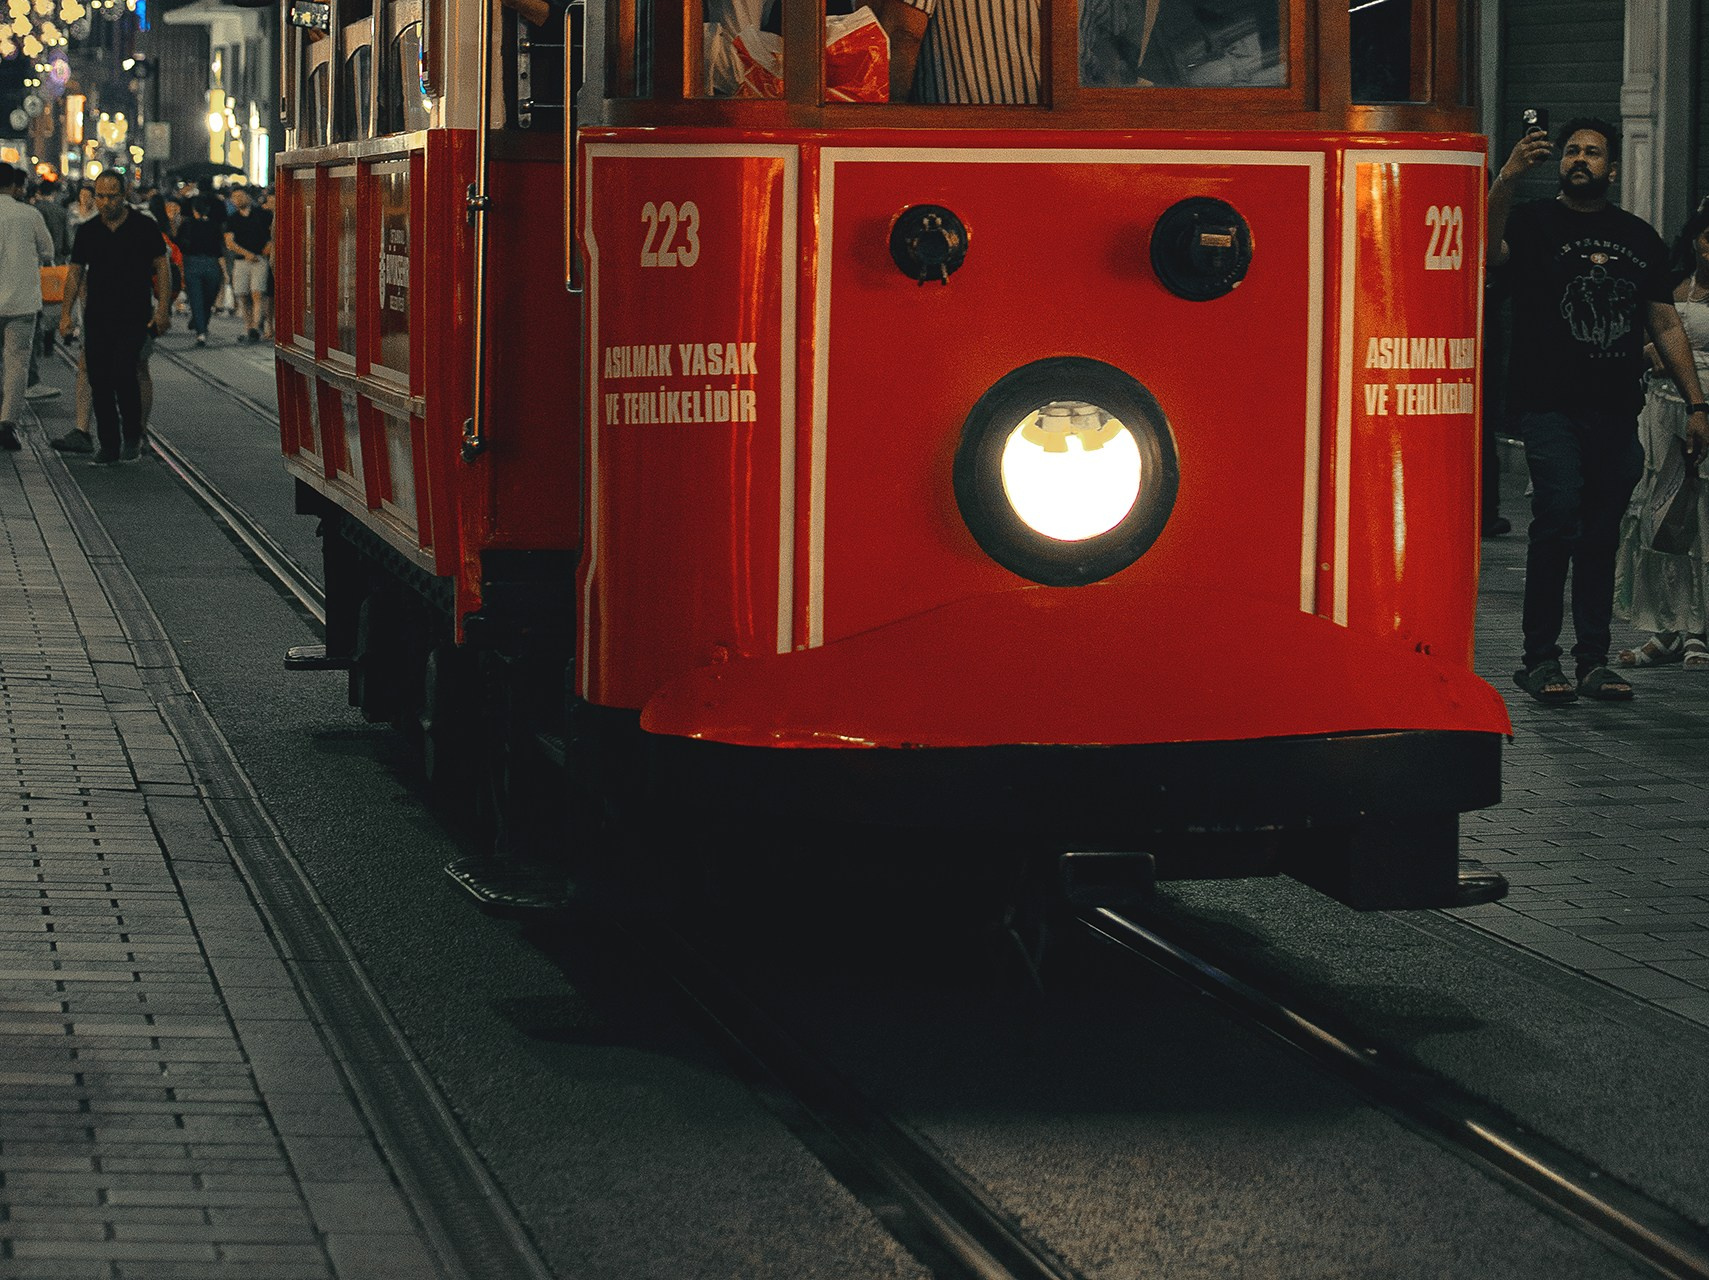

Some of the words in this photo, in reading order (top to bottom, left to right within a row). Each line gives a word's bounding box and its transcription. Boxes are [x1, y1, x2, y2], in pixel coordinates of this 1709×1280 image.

[640, 201, 700, 268] 223
[1425, 205, 1463, 270] 223
[604, 345, 672, 379] ASILMAK
[679, 342, 758, 376] YASAK
[1365, 337, 1447, 369] ASILMAK
[605, 393, 620, 425] VE
[623, 384, 757, 424] TEHLİKELİDİR
[1363, 383, 1389, 416] VE
